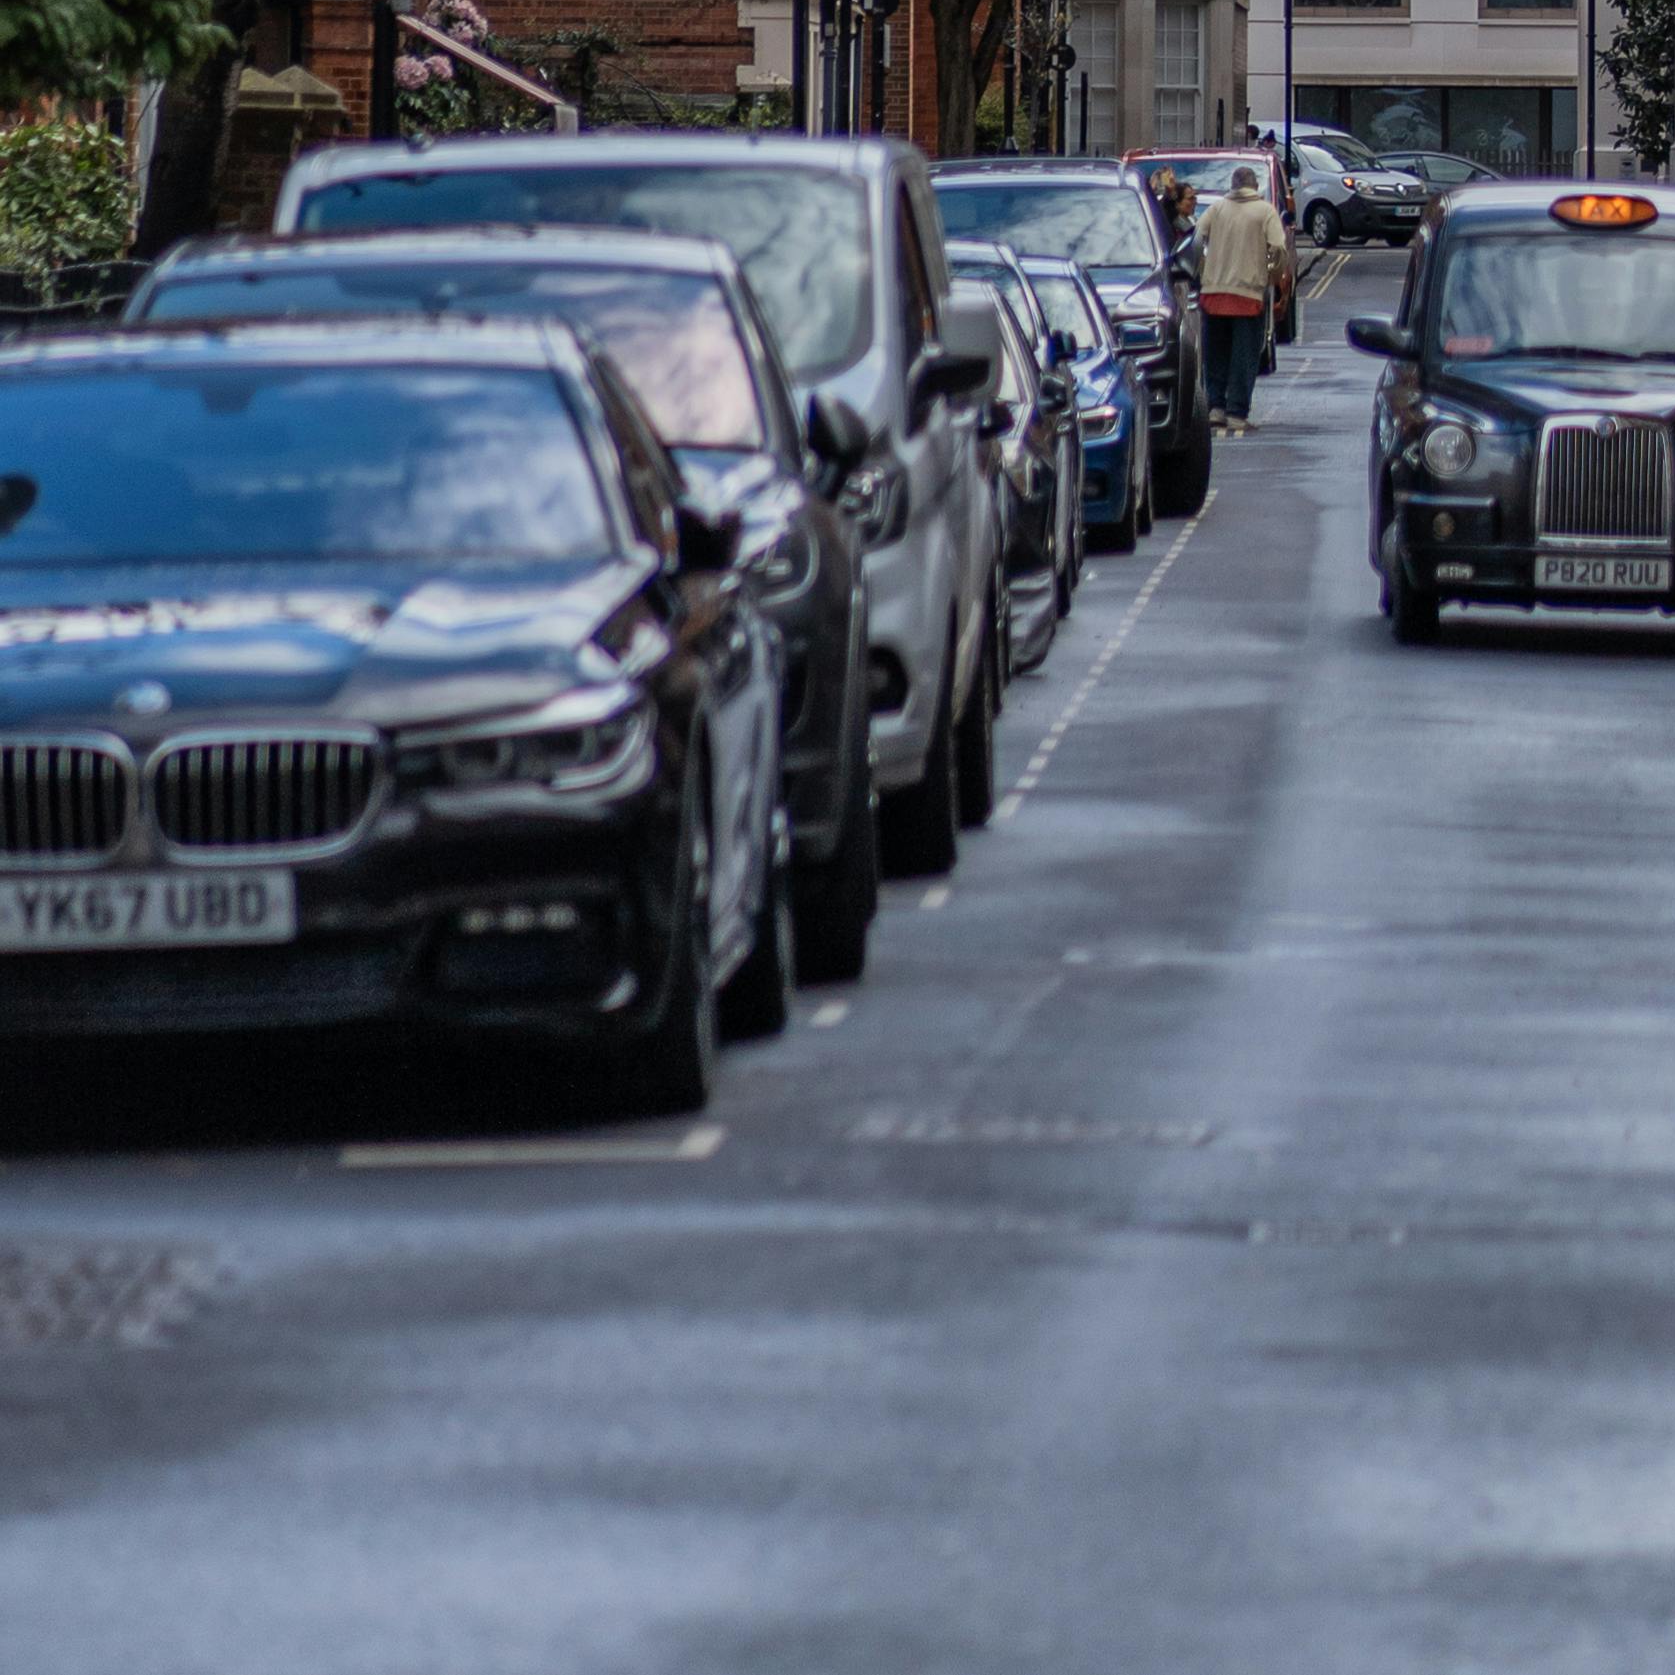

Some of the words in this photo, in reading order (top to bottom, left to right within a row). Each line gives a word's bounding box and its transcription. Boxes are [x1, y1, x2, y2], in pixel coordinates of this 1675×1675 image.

[1576, 200, 1633, 219] TAXI
[1613, 561, 1660, 586] RUU
[16, 885, 148, 934] YK67
